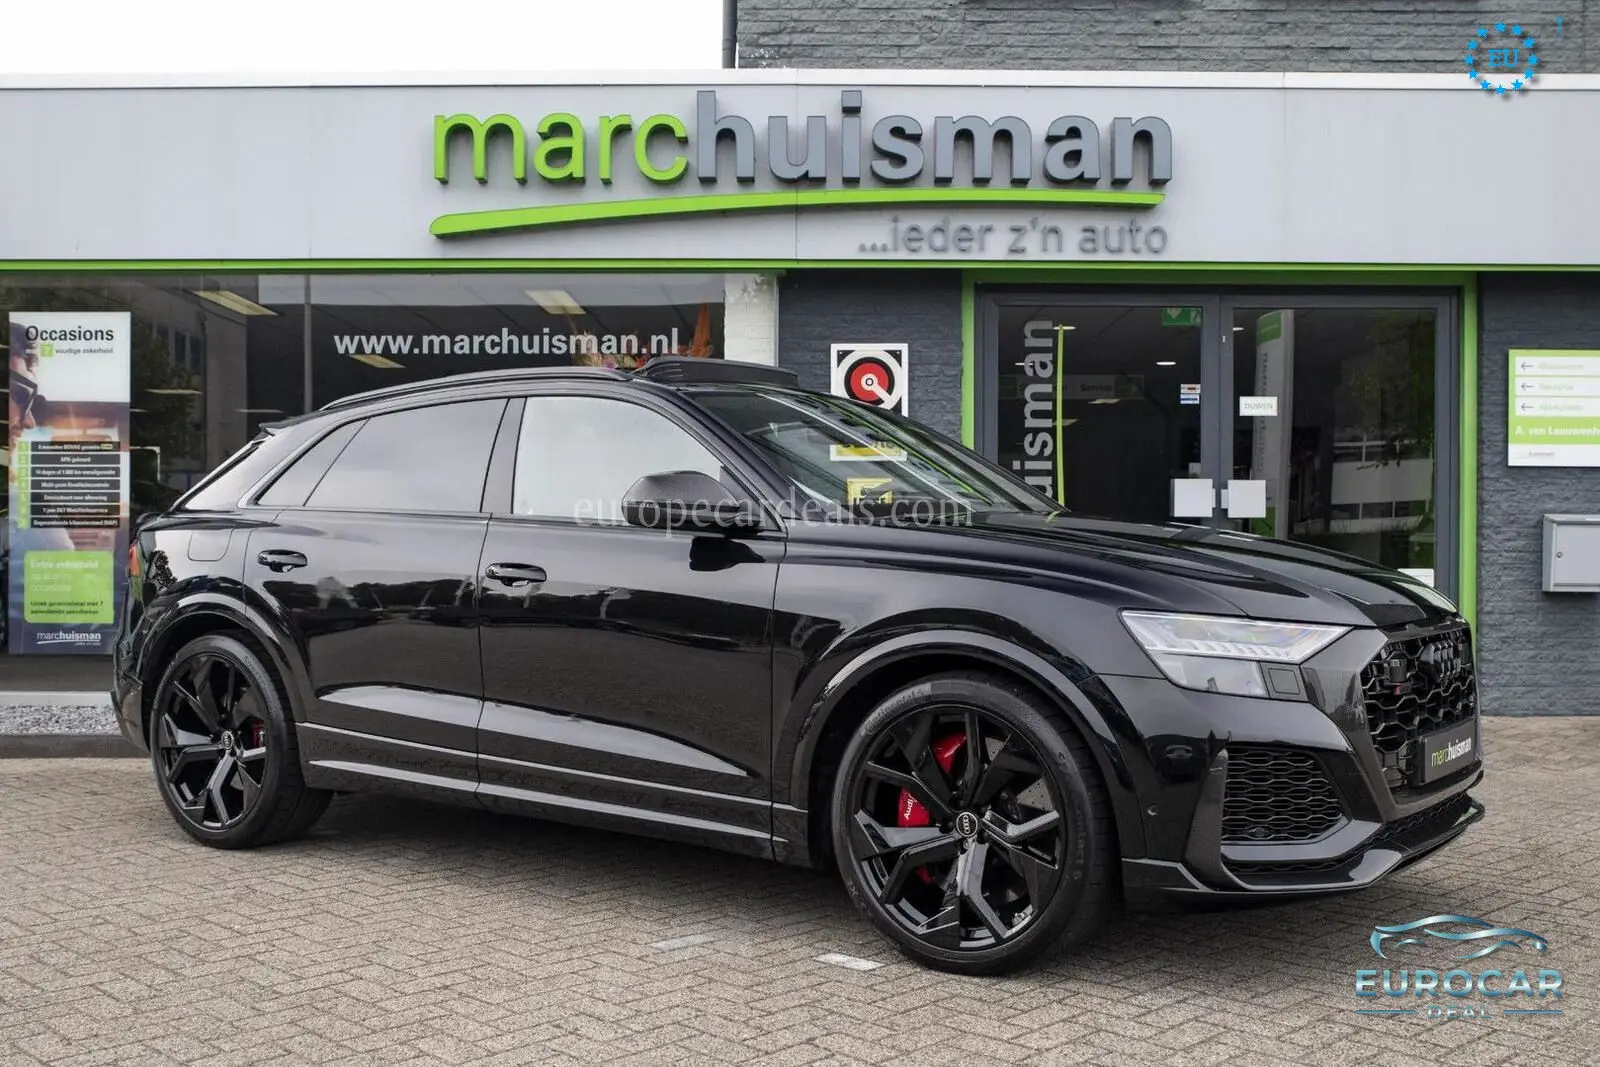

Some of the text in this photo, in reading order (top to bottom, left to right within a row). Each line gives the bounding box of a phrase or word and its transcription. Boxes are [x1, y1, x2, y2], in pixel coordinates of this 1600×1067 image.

[433, 90, 1173, 185] marchuisman
[1008, 217, 1063, 252] z'n
[1078, 217, 1168, 253] auto
[26, 325, 114, 342] Occasions
[334, 328, 679, 355] www.marchuisman.nl
[1529, 427, 1546, 435] van
[36, 630, 102, 641] marchuisman
[1430, 737, 1472, 768] marchuisman
[903, 798, 914, 821] Audi
